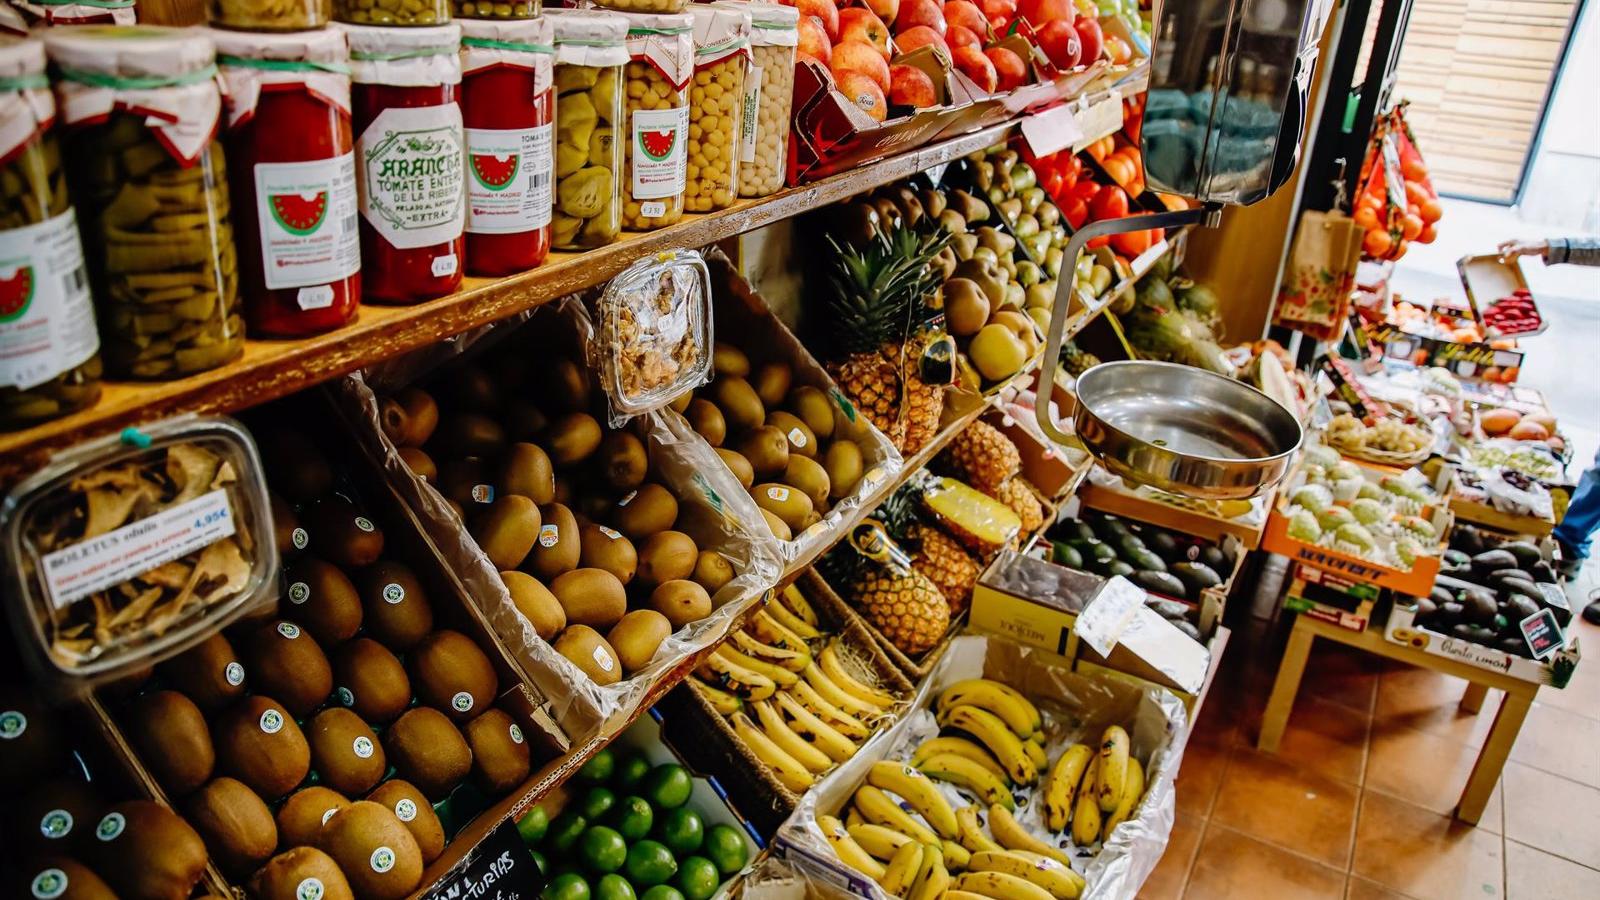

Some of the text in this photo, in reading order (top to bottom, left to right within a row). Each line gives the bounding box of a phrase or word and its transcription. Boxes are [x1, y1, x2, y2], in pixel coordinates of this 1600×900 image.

[376, 180, 424, 191] TOMATE
[394, 193, 407, 202] DE
[411, 193, 424, 201] LA
